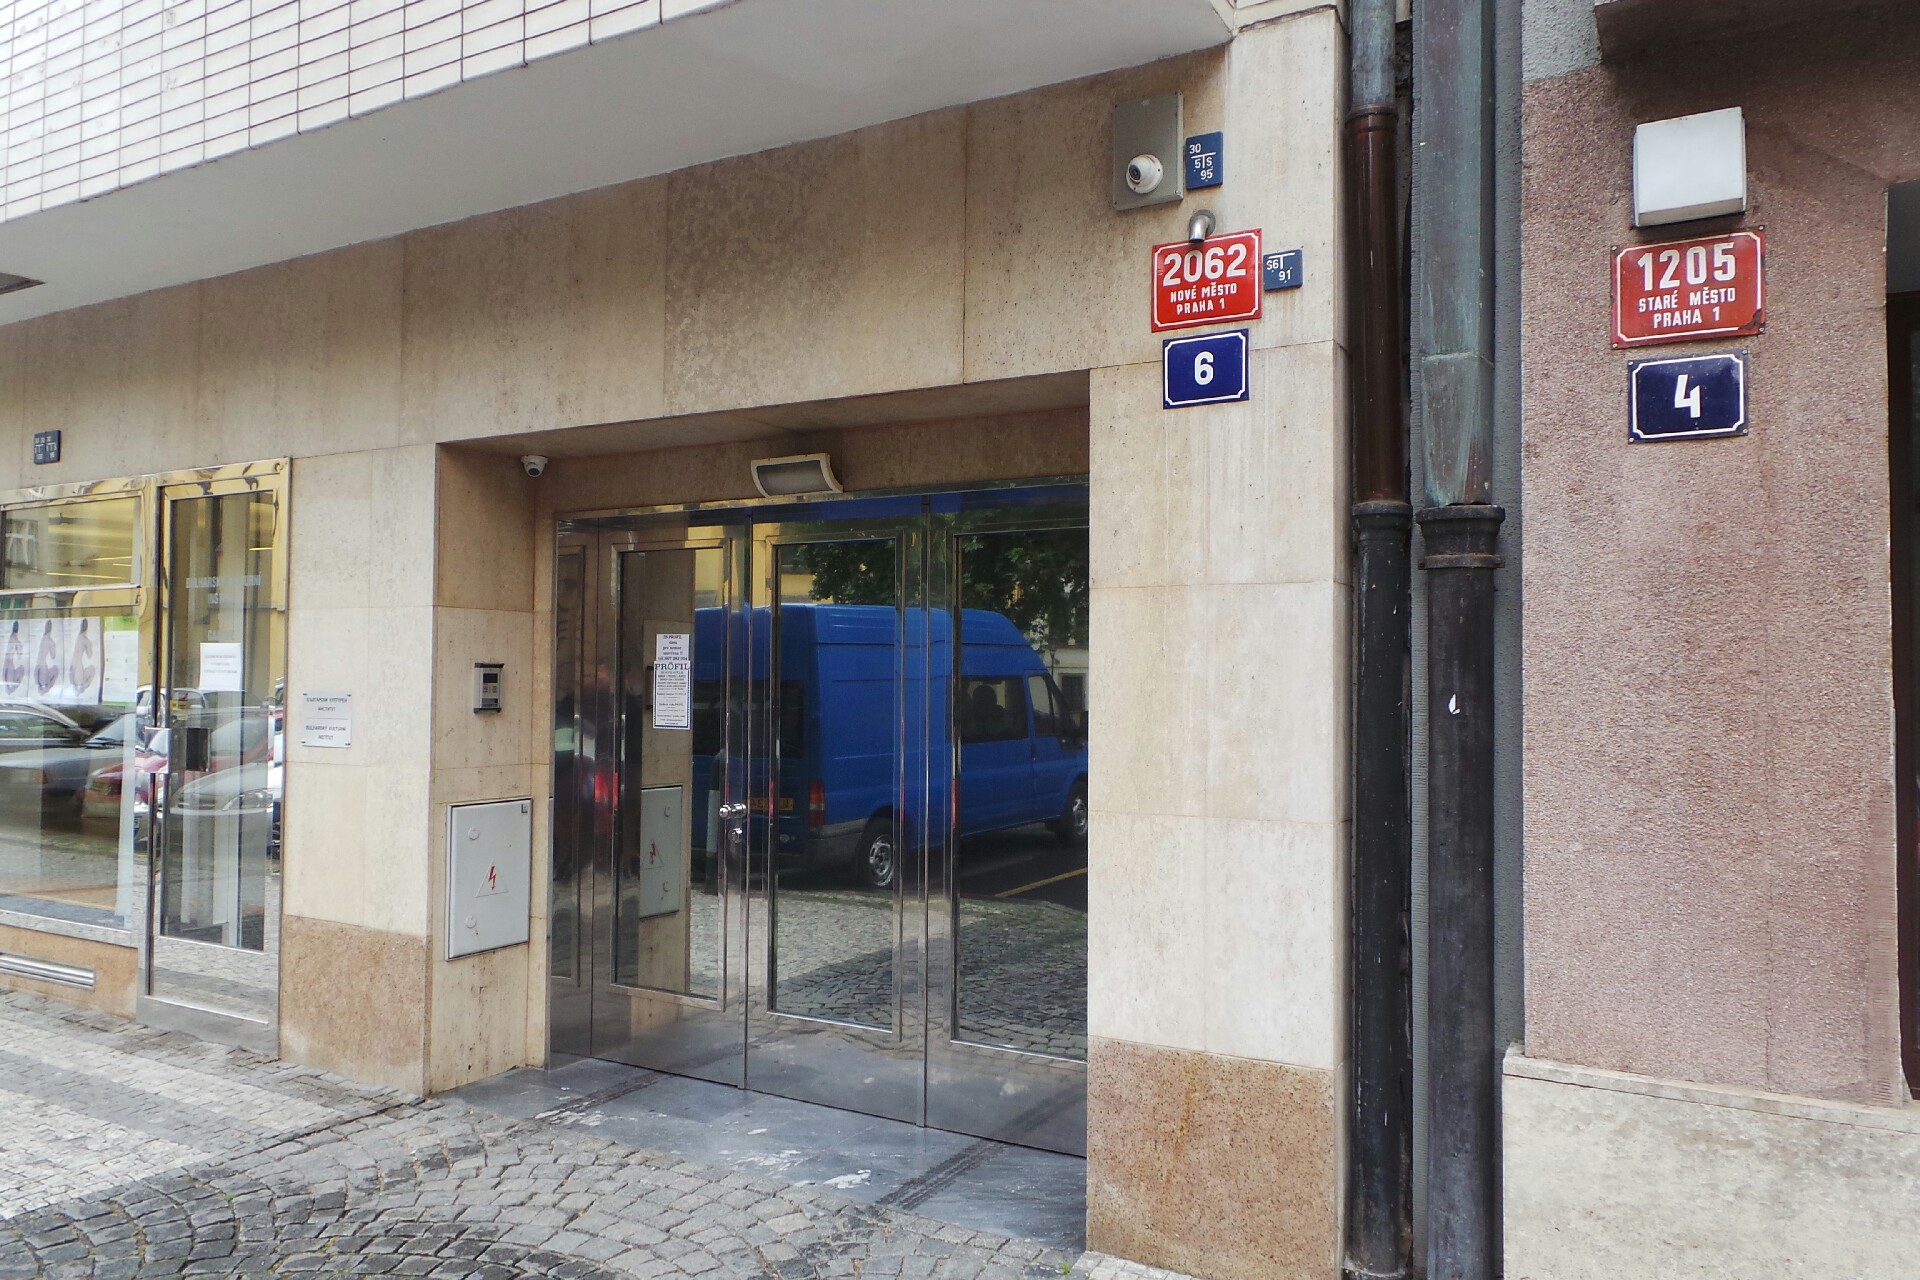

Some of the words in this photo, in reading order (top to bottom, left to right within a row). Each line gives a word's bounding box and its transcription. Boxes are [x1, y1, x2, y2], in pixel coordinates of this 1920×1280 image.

[1189, 143, 1202, 154] 30
[1200, 168, 1213, 181] 95
[1163, 243, 1247, 287] 2062
[1278, 269, 1291, 281] 91
[1637, 241, 1736, 291] 1205
[1170, 285, 1197, 303] NOVÉ
[1201, 281, 1238, 298] MĚSTO
[1638, 290, 1679, 312] STARÉ
[1689, 286, 1736, 306] MĚSTO
[1176, 299, 1214, 315] PRAHA
[1219, 297, 1226, 309] 1
[1653, 308, 1703, 329] PRAHA
[1712, 306, 1720, 321] 1
[1193, 350, 1215, 386] 6
[1674, 373, 1701, 418] 4
